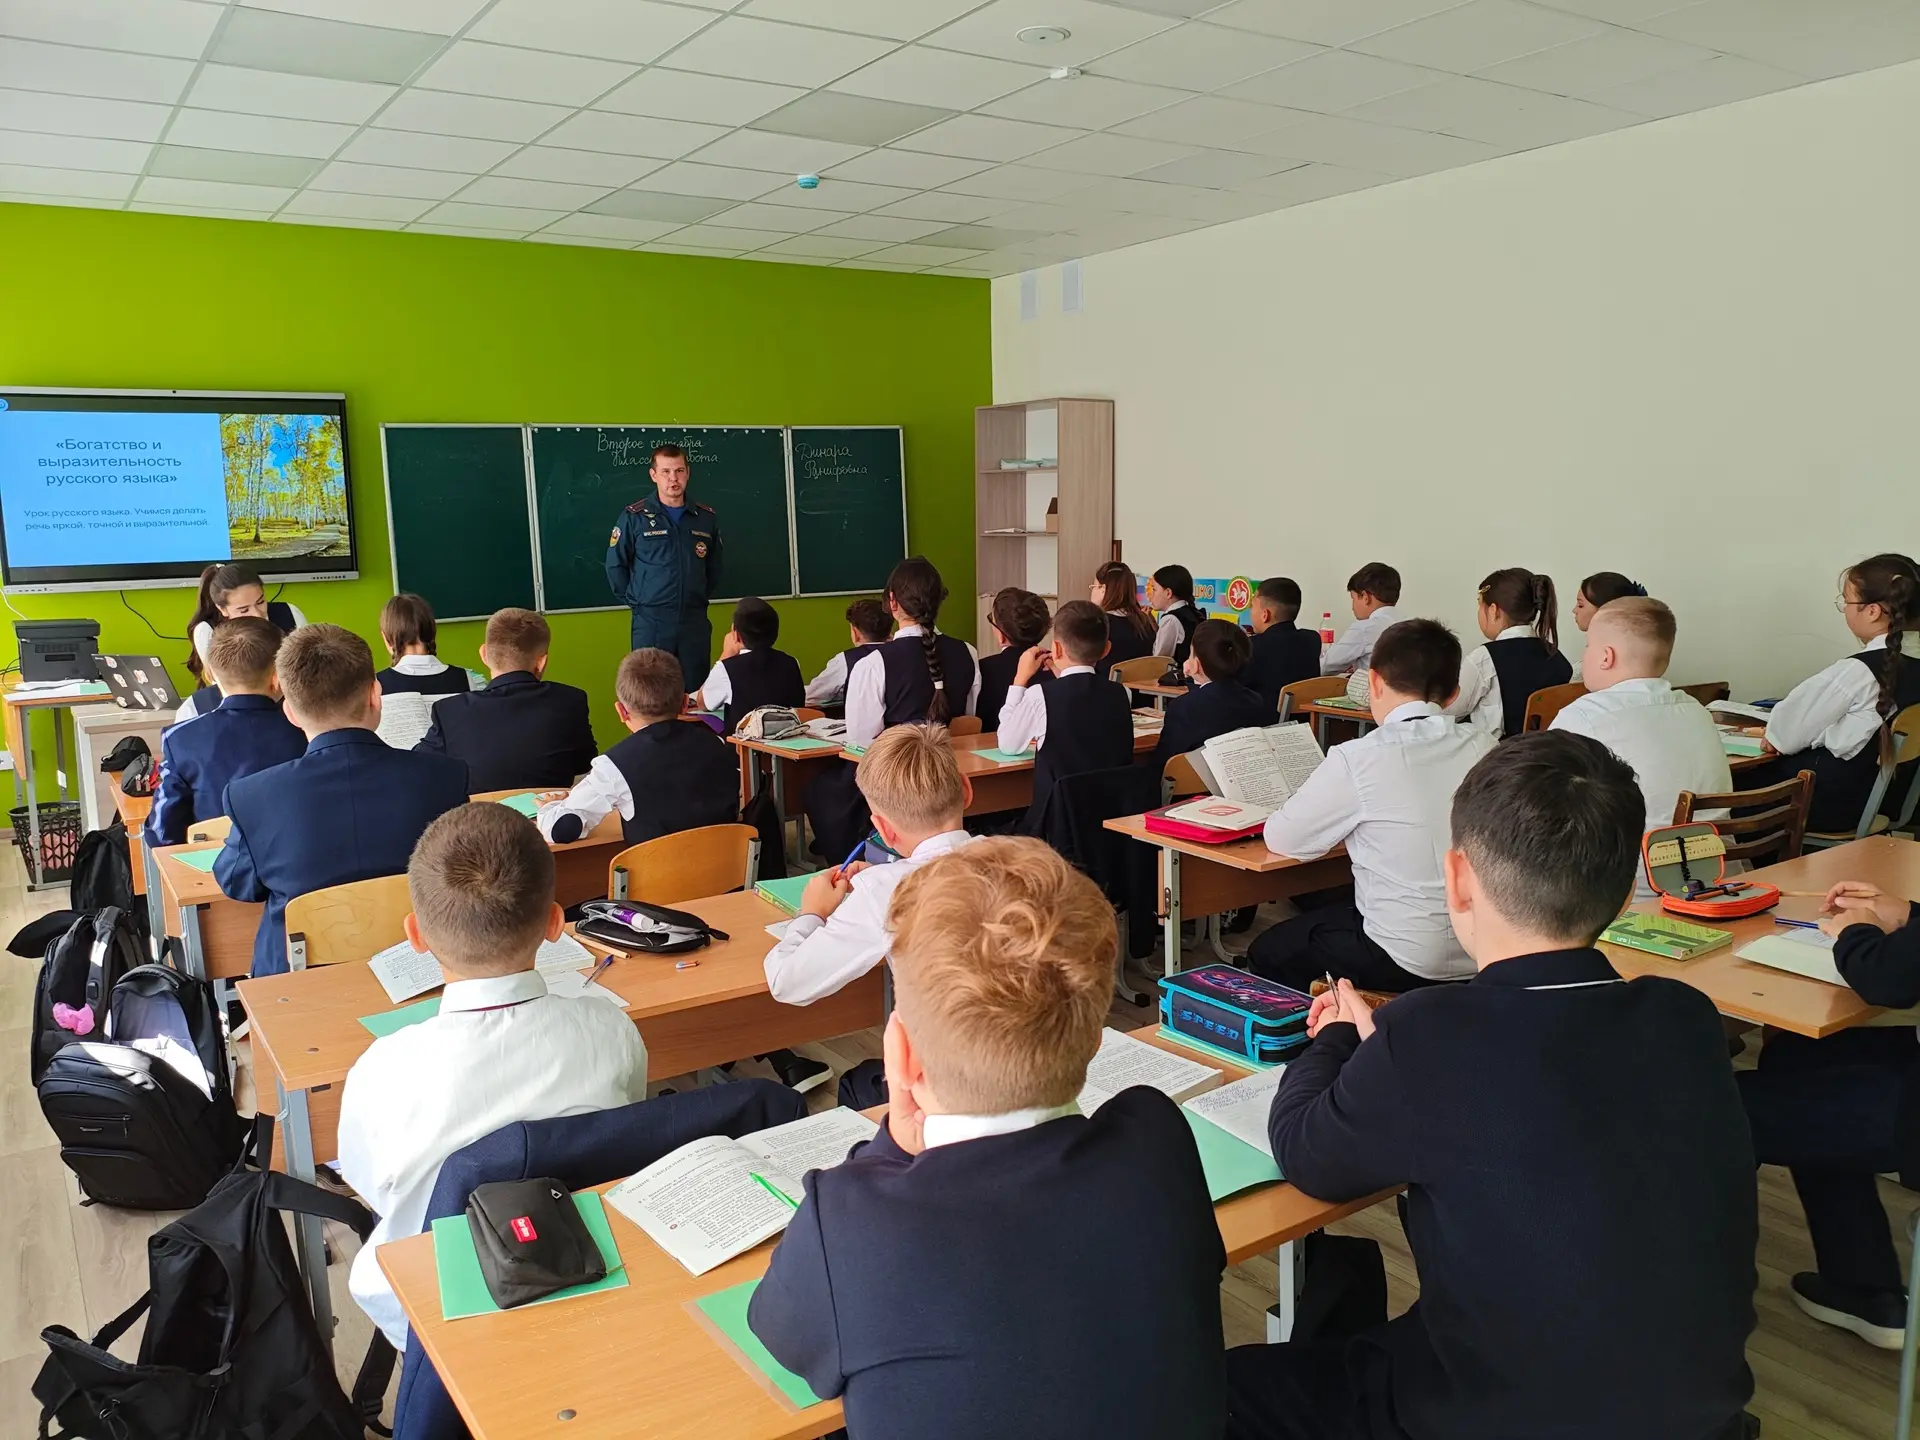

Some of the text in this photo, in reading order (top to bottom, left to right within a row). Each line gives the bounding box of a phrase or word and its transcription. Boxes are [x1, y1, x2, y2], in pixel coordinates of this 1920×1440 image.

[56, 438, 162, 450] «Богатство и
[597, 433, 644, 458] Второе
[611, 449, 652, 466] Класс
[795, 443, 852, 465] Динара
[38, 457, 182, 469] выразительность
[46, 474, 177, 486] русского языка»
[24, 507, 206, 518] Урок русского языка. Учимся делать
[25, 522, 50, 531] речь
[88, 520, 124, 529] точной
[1180, 1009, 1240, 1041] SPEED
